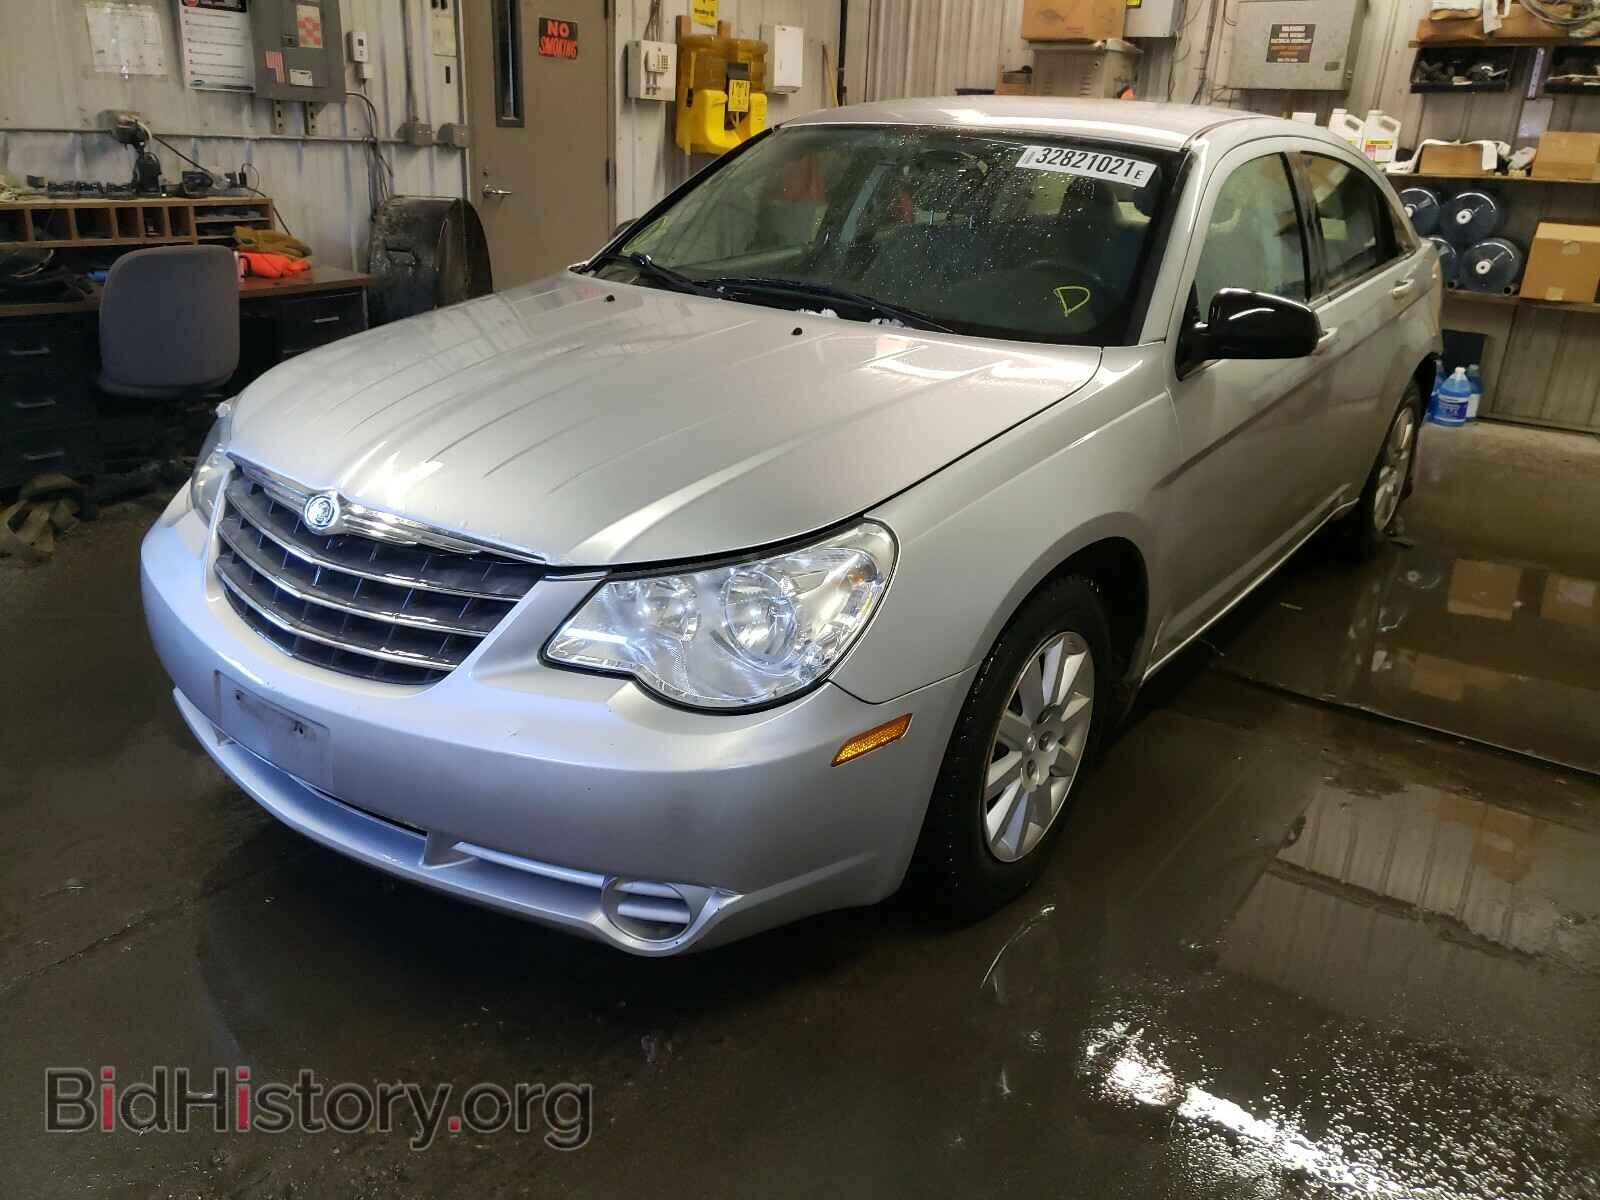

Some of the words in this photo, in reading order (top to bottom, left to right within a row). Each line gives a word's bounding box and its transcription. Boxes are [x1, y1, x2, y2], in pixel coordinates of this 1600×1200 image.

[547, 20, 570, 38] NO
[539, 36, 578, 58] SMOKING
[1035, 147, 1136, 178] 32821021
[1133, 170, 1145, 181] E
